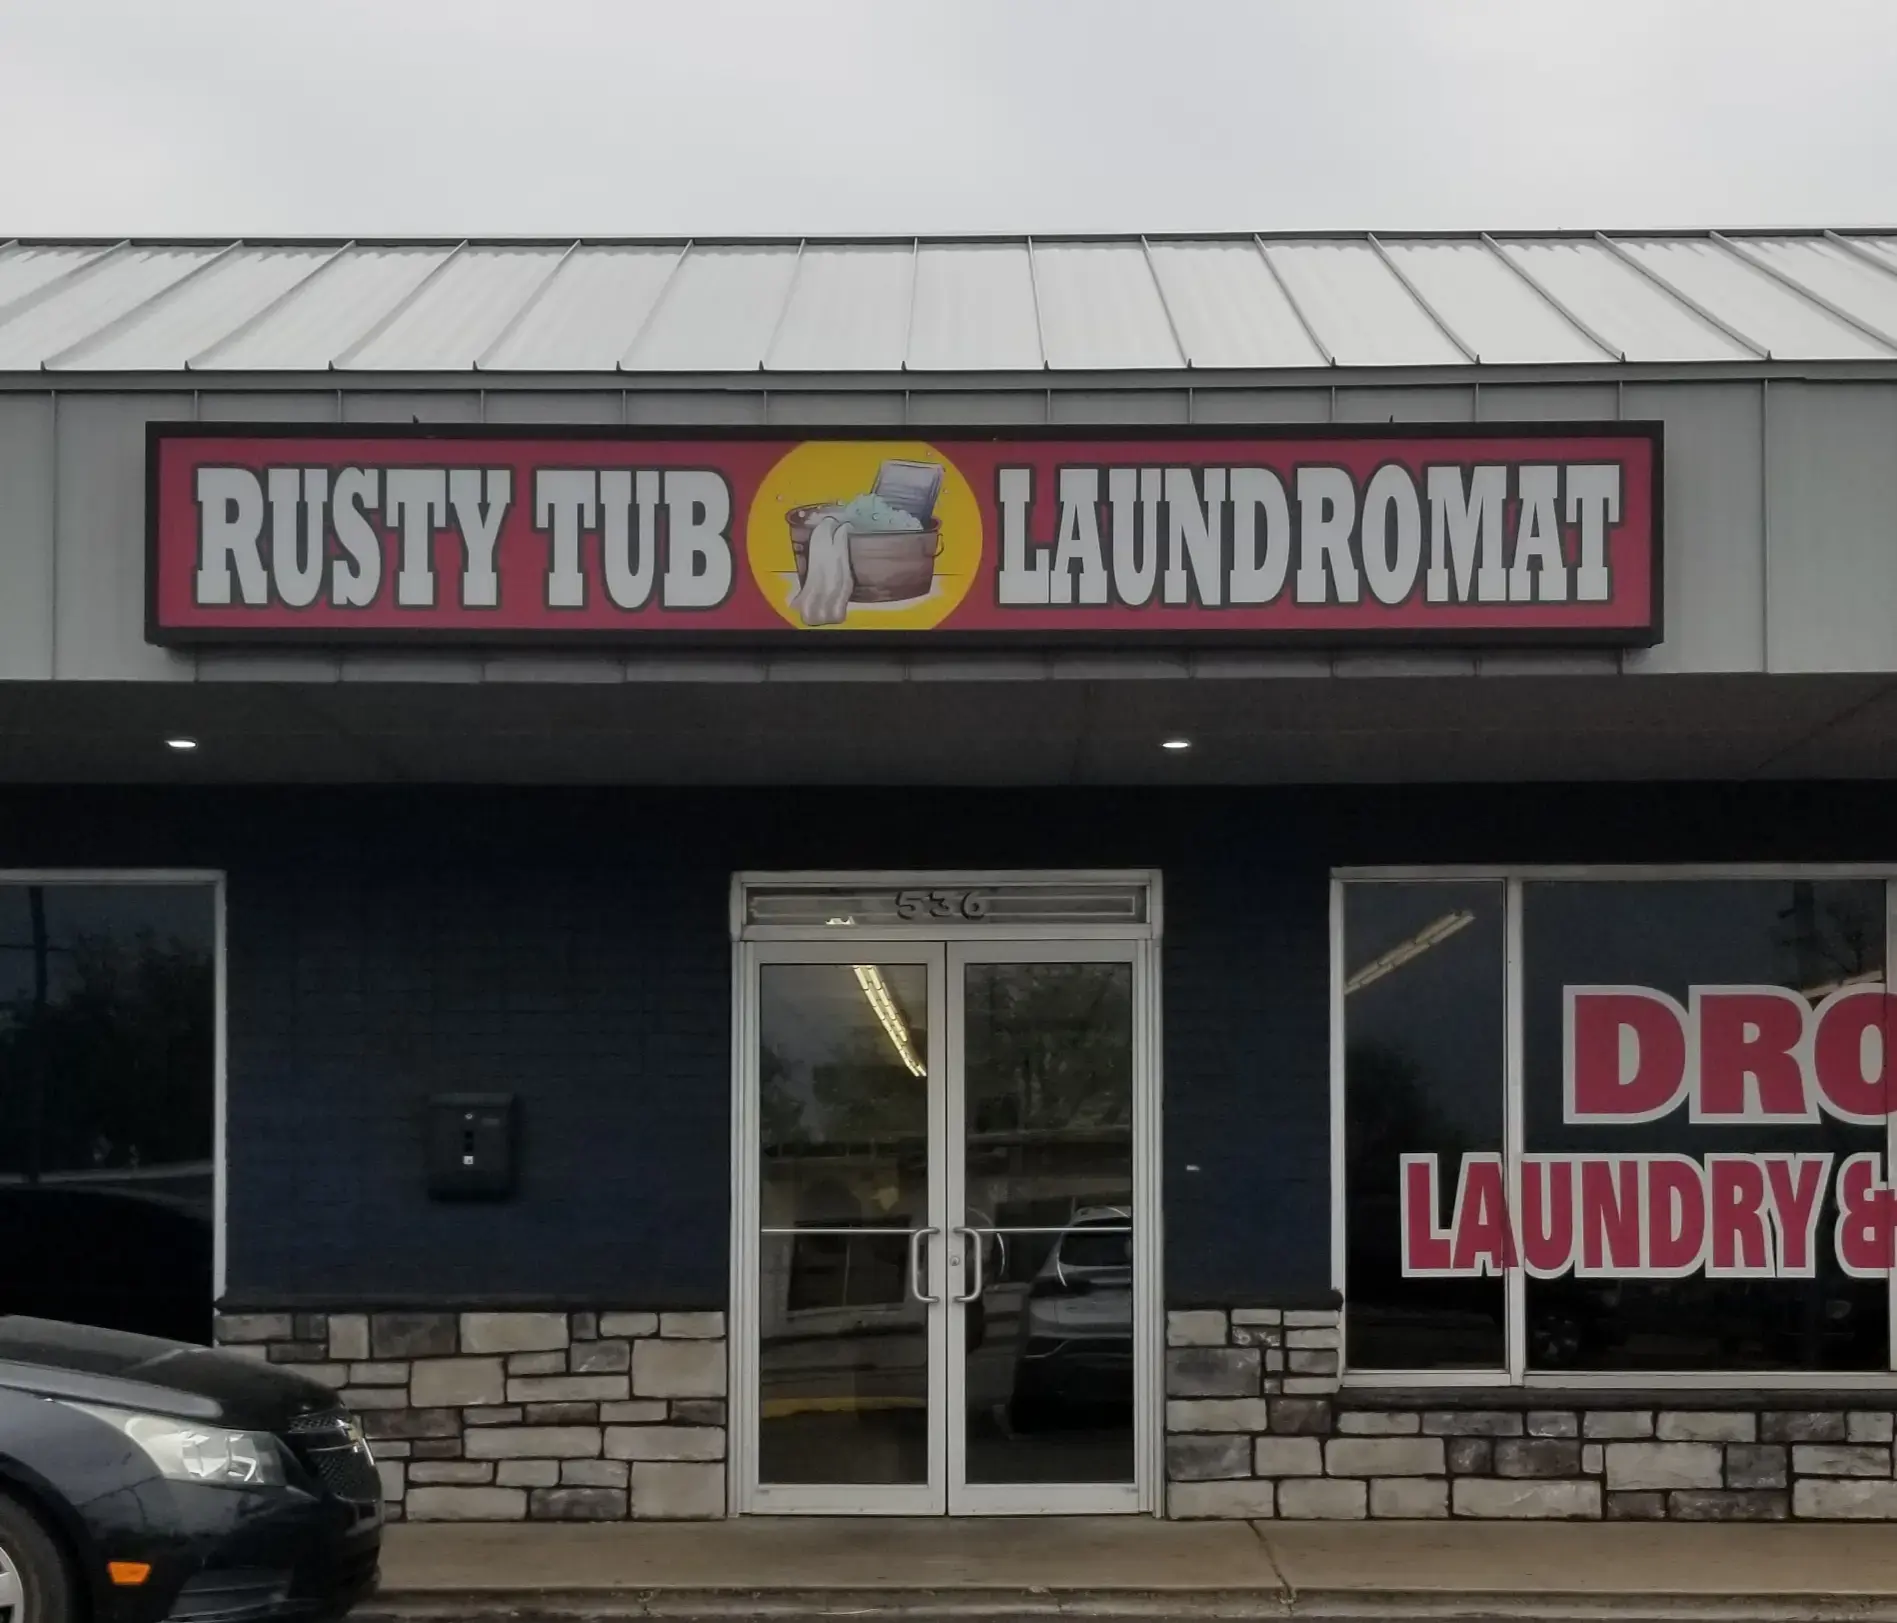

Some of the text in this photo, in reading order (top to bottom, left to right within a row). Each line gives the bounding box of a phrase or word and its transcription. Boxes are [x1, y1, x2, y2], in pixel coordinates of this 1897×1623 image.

[196, 464, 1621, 609] RUSTY TUB LAUNDROMAT
[896, 891, 988, 920] 536
[1563, 984, 1897, 1124] DRO
[1400, 1152, 1897, 1278] LAUNDRY &
